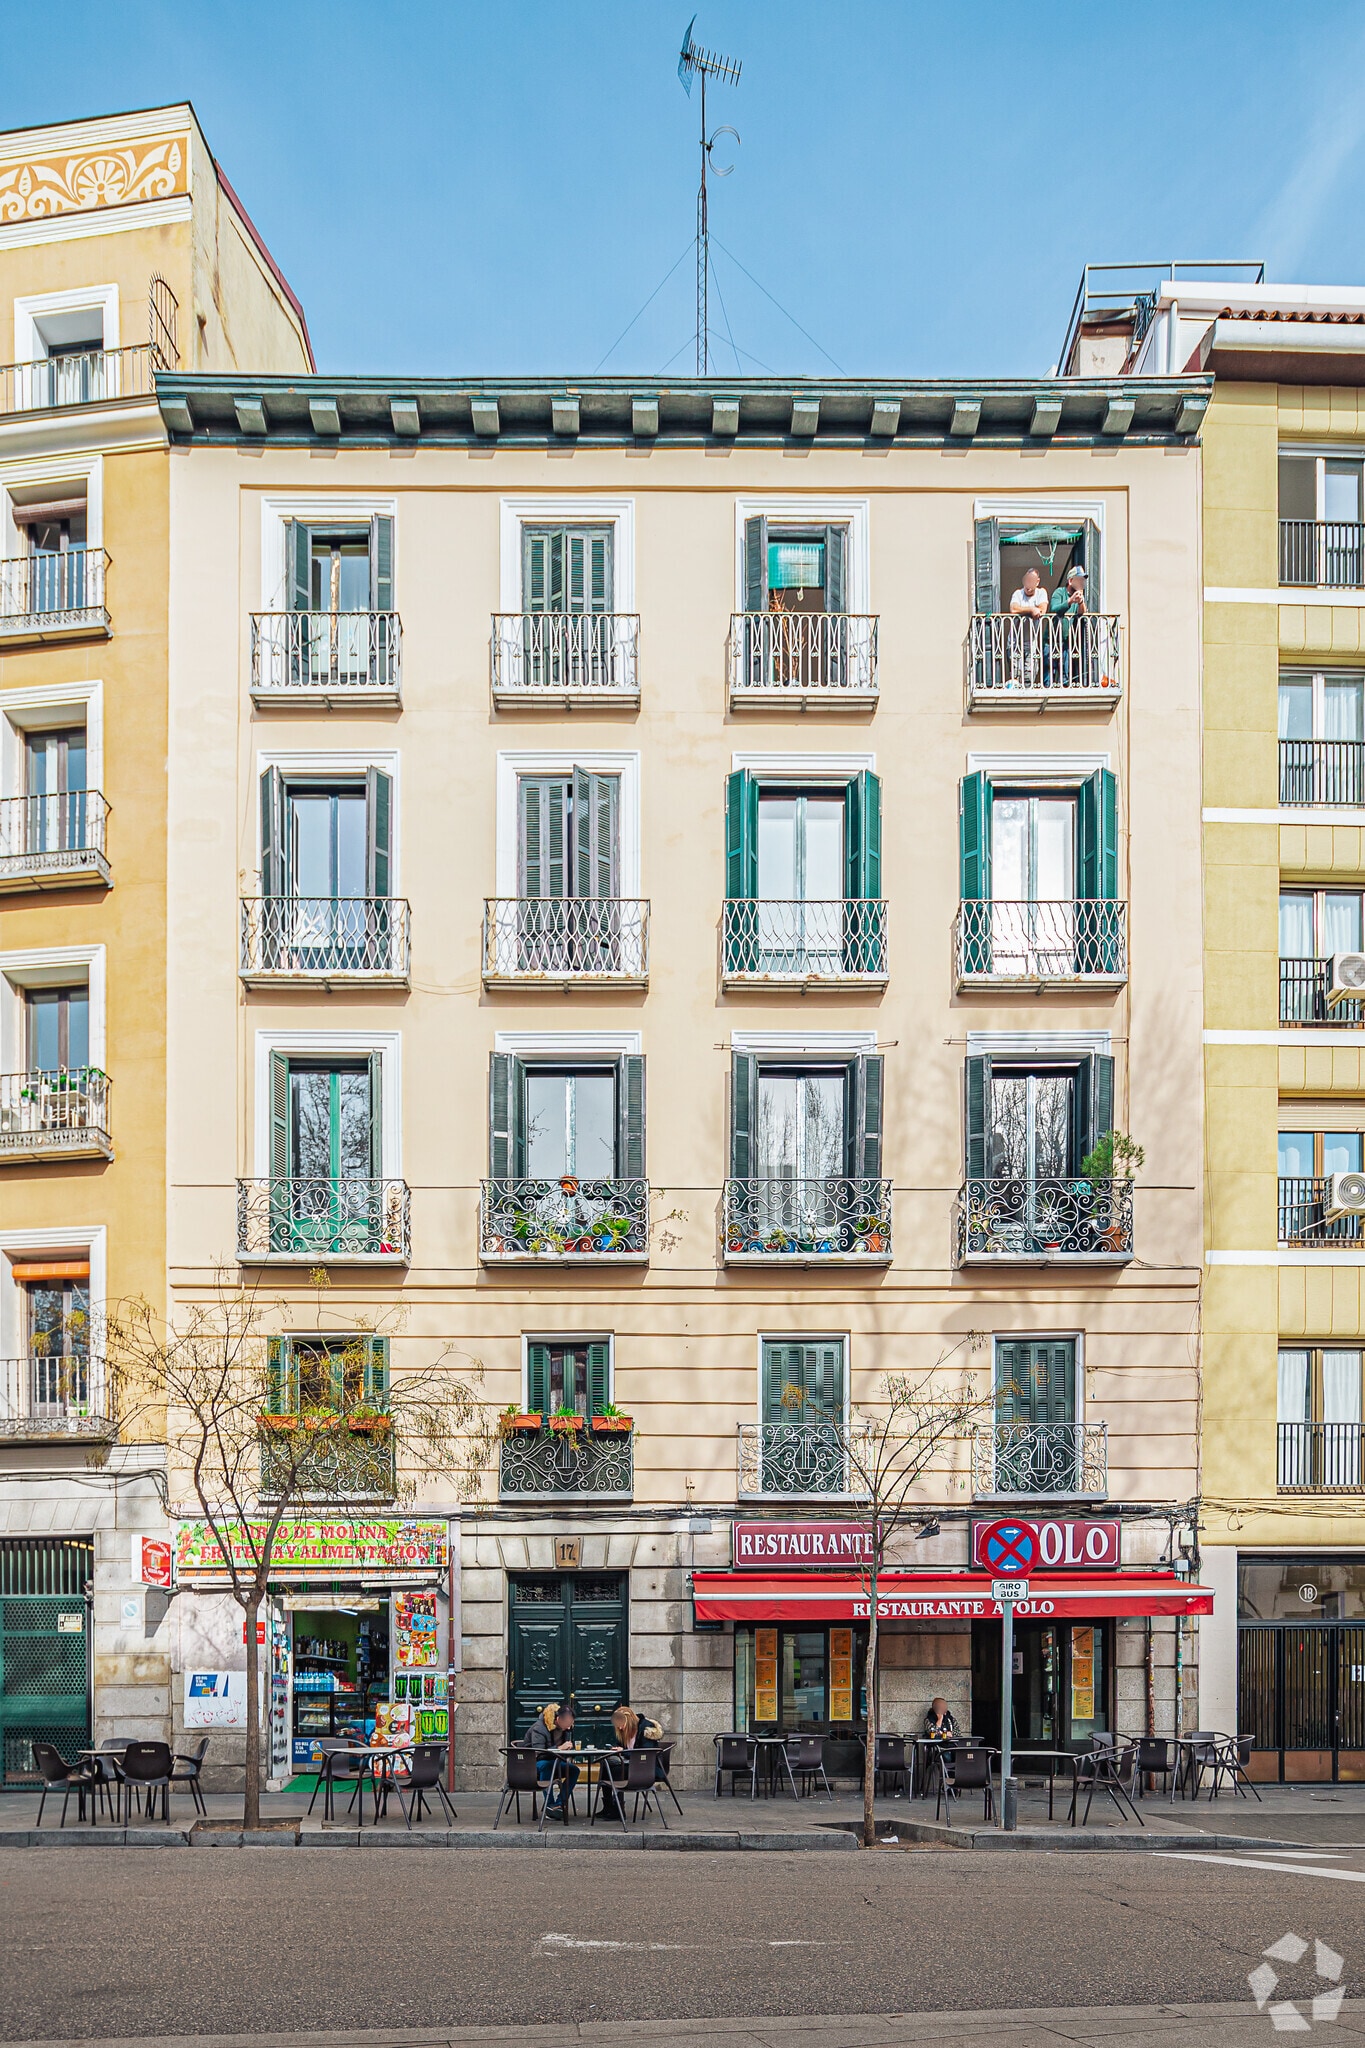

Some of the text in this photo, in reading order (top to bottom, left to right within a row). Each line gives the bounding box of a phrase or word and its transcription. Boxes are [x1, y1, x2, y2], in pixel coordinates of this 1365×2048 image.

[239, 1525, 389, 1539] TIRO DE MOLINA
[740, 1533, 875, 1556] RESTAURANTE
[1031, 1522, 1109, 1565] OLO
[200, 1545, 284, 1559] FRTERA
[286, 1545, 298, 1559] Y
[999, 1582, 1021, 1590] GIRO
[1000, 1590, 1020, 1598] BUS
[1303, 1587, 1314, 1600] 18
